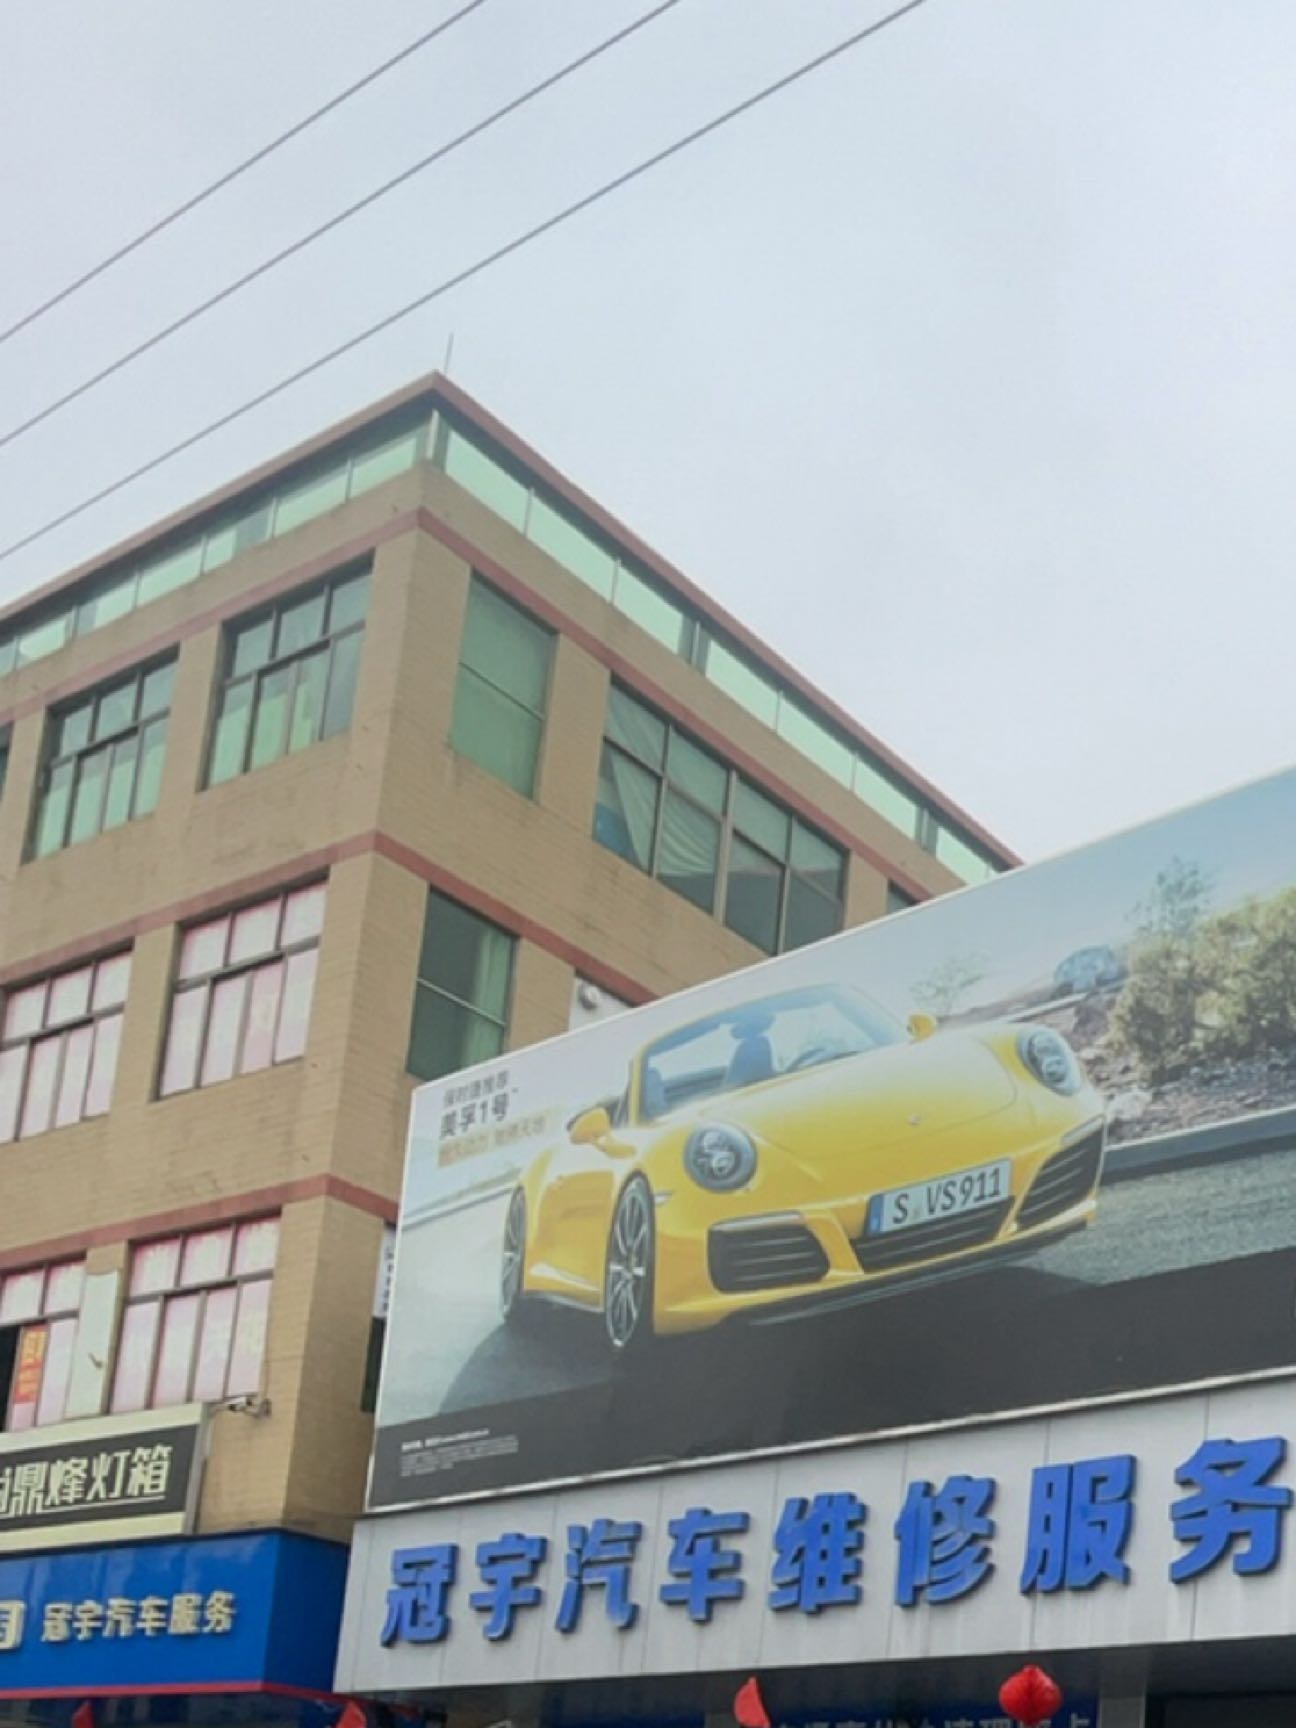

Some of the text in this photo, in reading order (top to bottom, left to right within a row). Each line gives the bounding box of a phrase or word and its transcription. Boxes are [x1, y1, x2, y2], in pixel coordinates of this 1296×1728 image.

[893, 1168, 1001, 1224] S VS911
[380, 1435, 1294, 1647] 冠宇汽车维修服务
